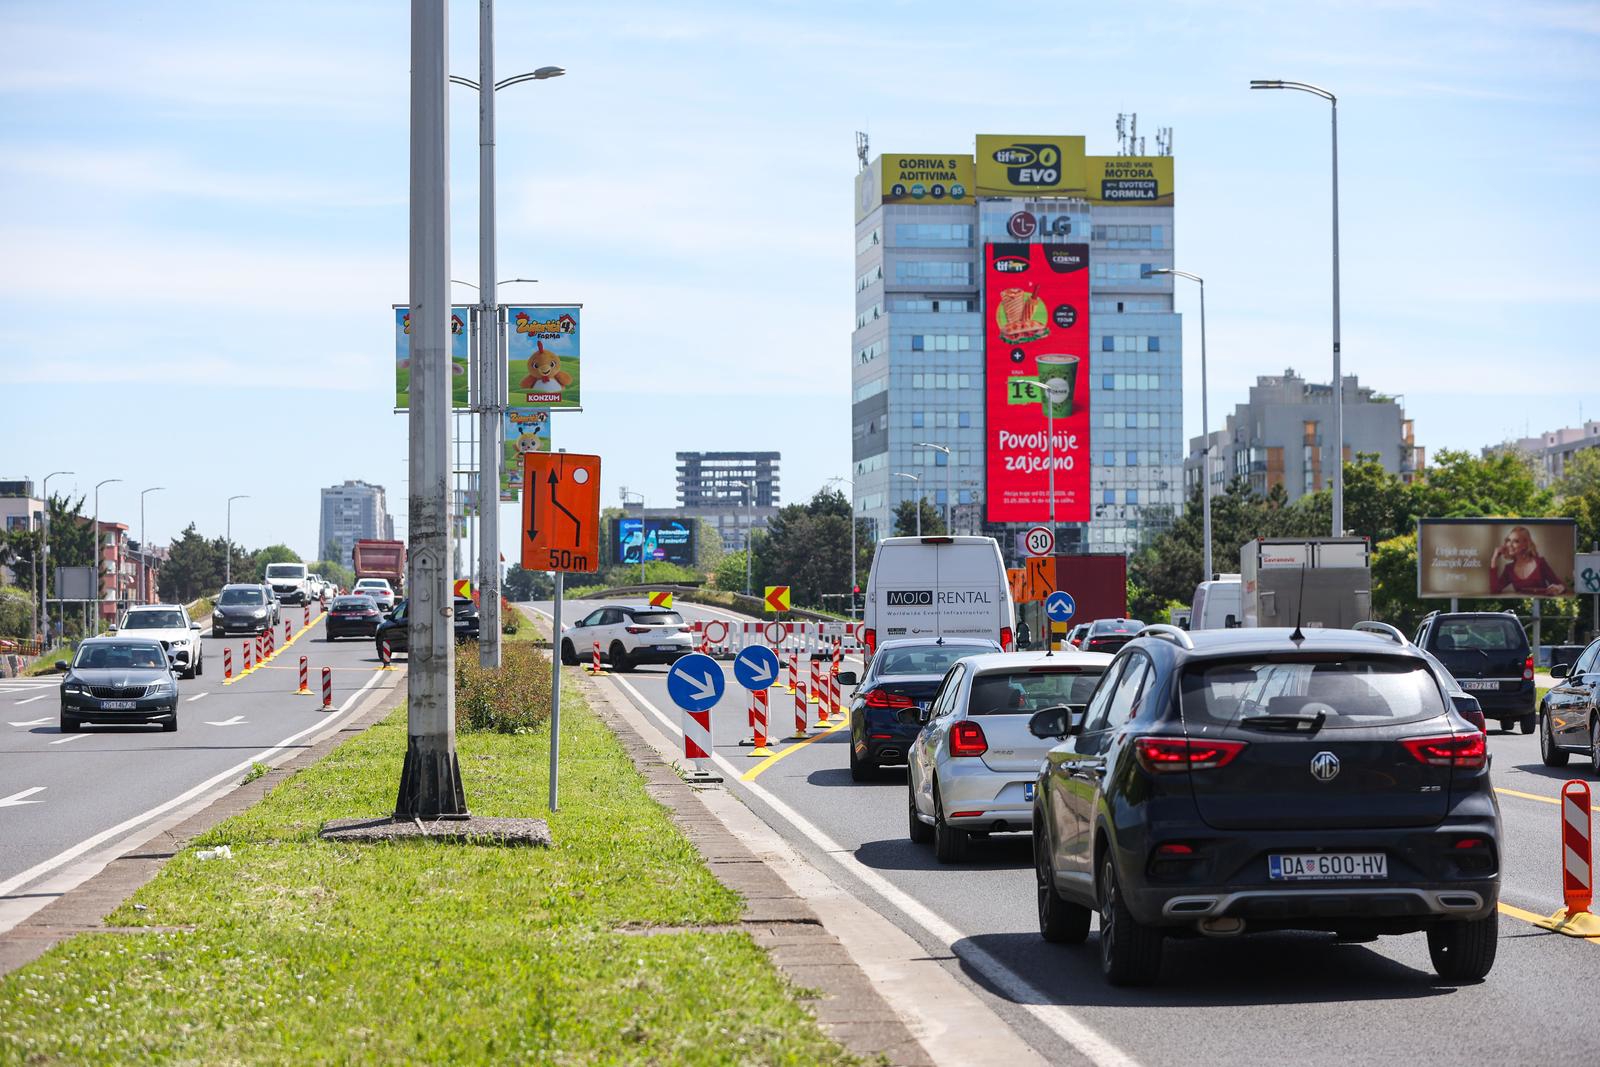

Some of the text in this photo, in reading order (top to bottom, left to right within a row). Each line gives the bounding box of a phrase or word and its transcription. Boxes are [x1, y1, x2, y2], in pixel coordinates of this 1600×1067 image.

[899, 159, 957, 169] GORIVA S
[900, 171, 957, 180] ADITIVIMA
[1019, 168, 1057, 182] EVO
[1105, 169, 1153, 177] MOTORA
[1105, 190, 1155, 198] FORMULA
[1039, 215, 1071, 236] LG
[562, 321, 570, 332] 4
[528, 394, 560, 402] KONZUM
[999, 430, 1078, 452] Povoljnije
[1031, 535, 1047, 549] 30
[890, 592, 991, 604] MOJO RENTAL
[1315, 755, 1336, 778] MG
[1282, 855, 1384, 874] DA 600-HV
